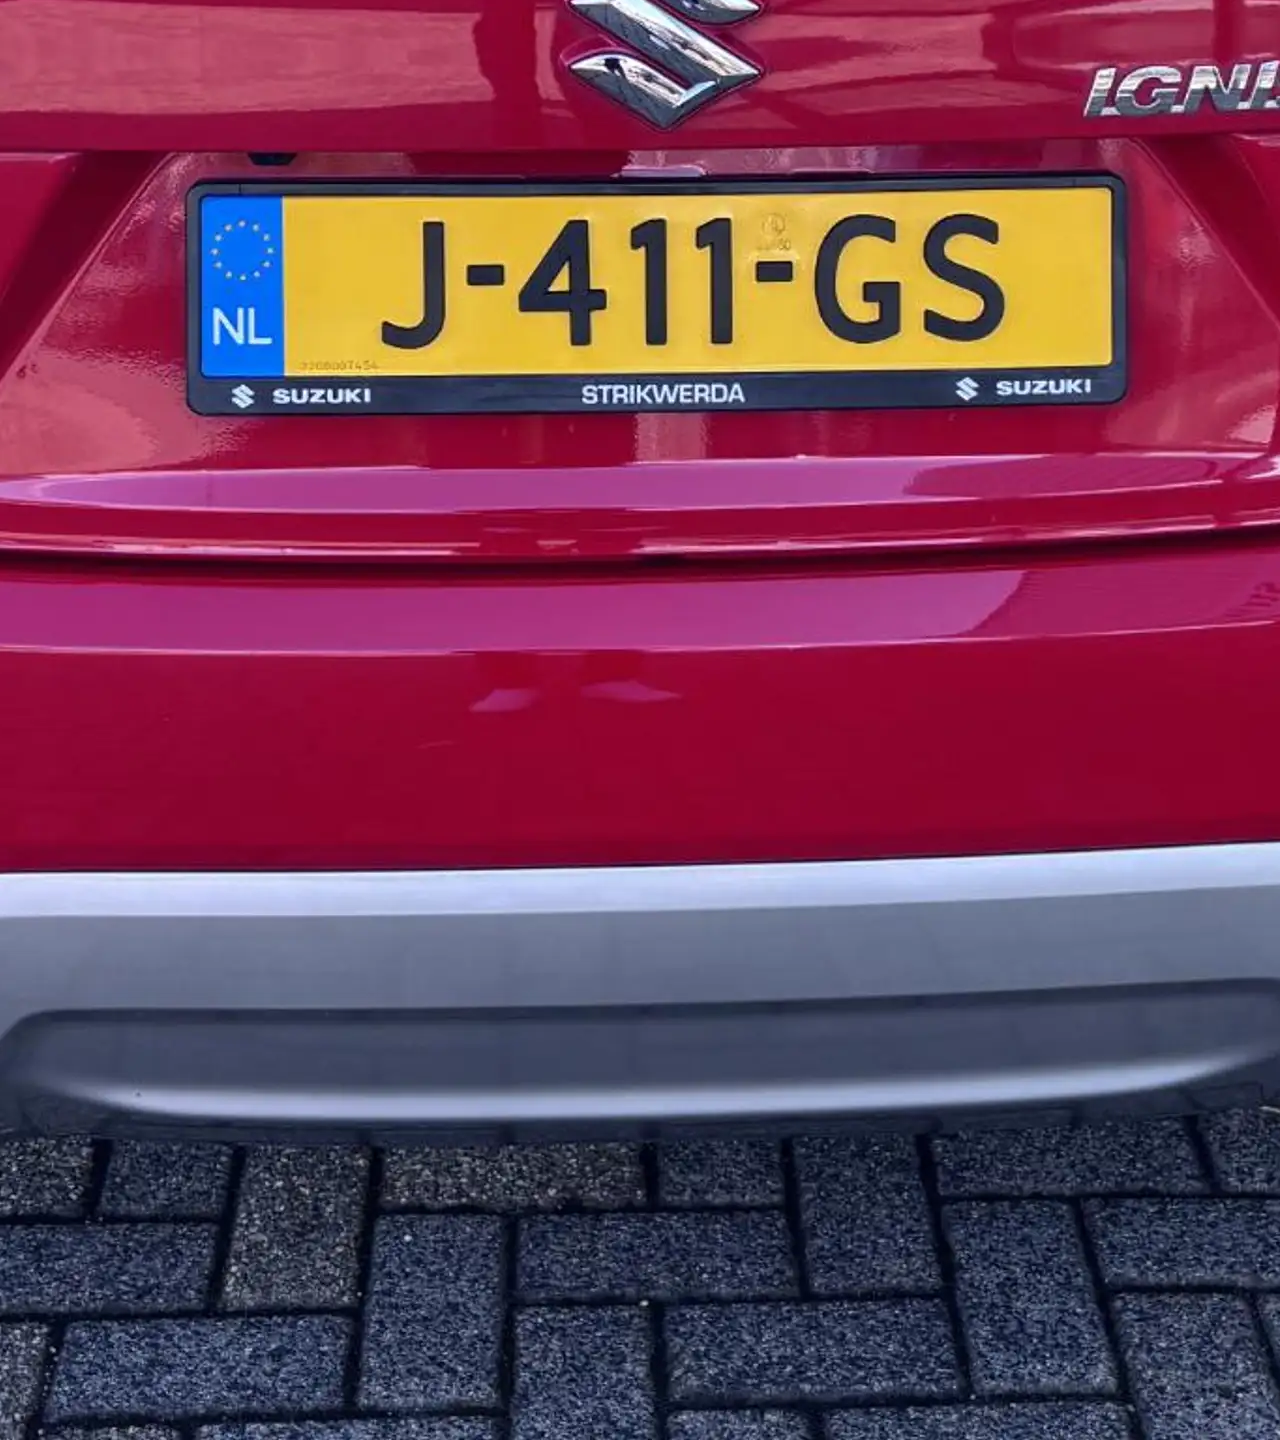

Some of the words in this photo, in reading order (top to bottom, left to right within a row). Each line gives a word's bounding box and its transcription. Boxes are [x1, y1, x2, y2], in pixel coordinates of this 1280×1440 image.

[381, 213, 1006, 350] J-411-GS
[211, 306, 273, 346] NL
[272, 387, 372, 405] SUZUKI
[580, 382, 746, 406] STRIKWERDA
[996, 378, 1092, 396] SUZUKI
